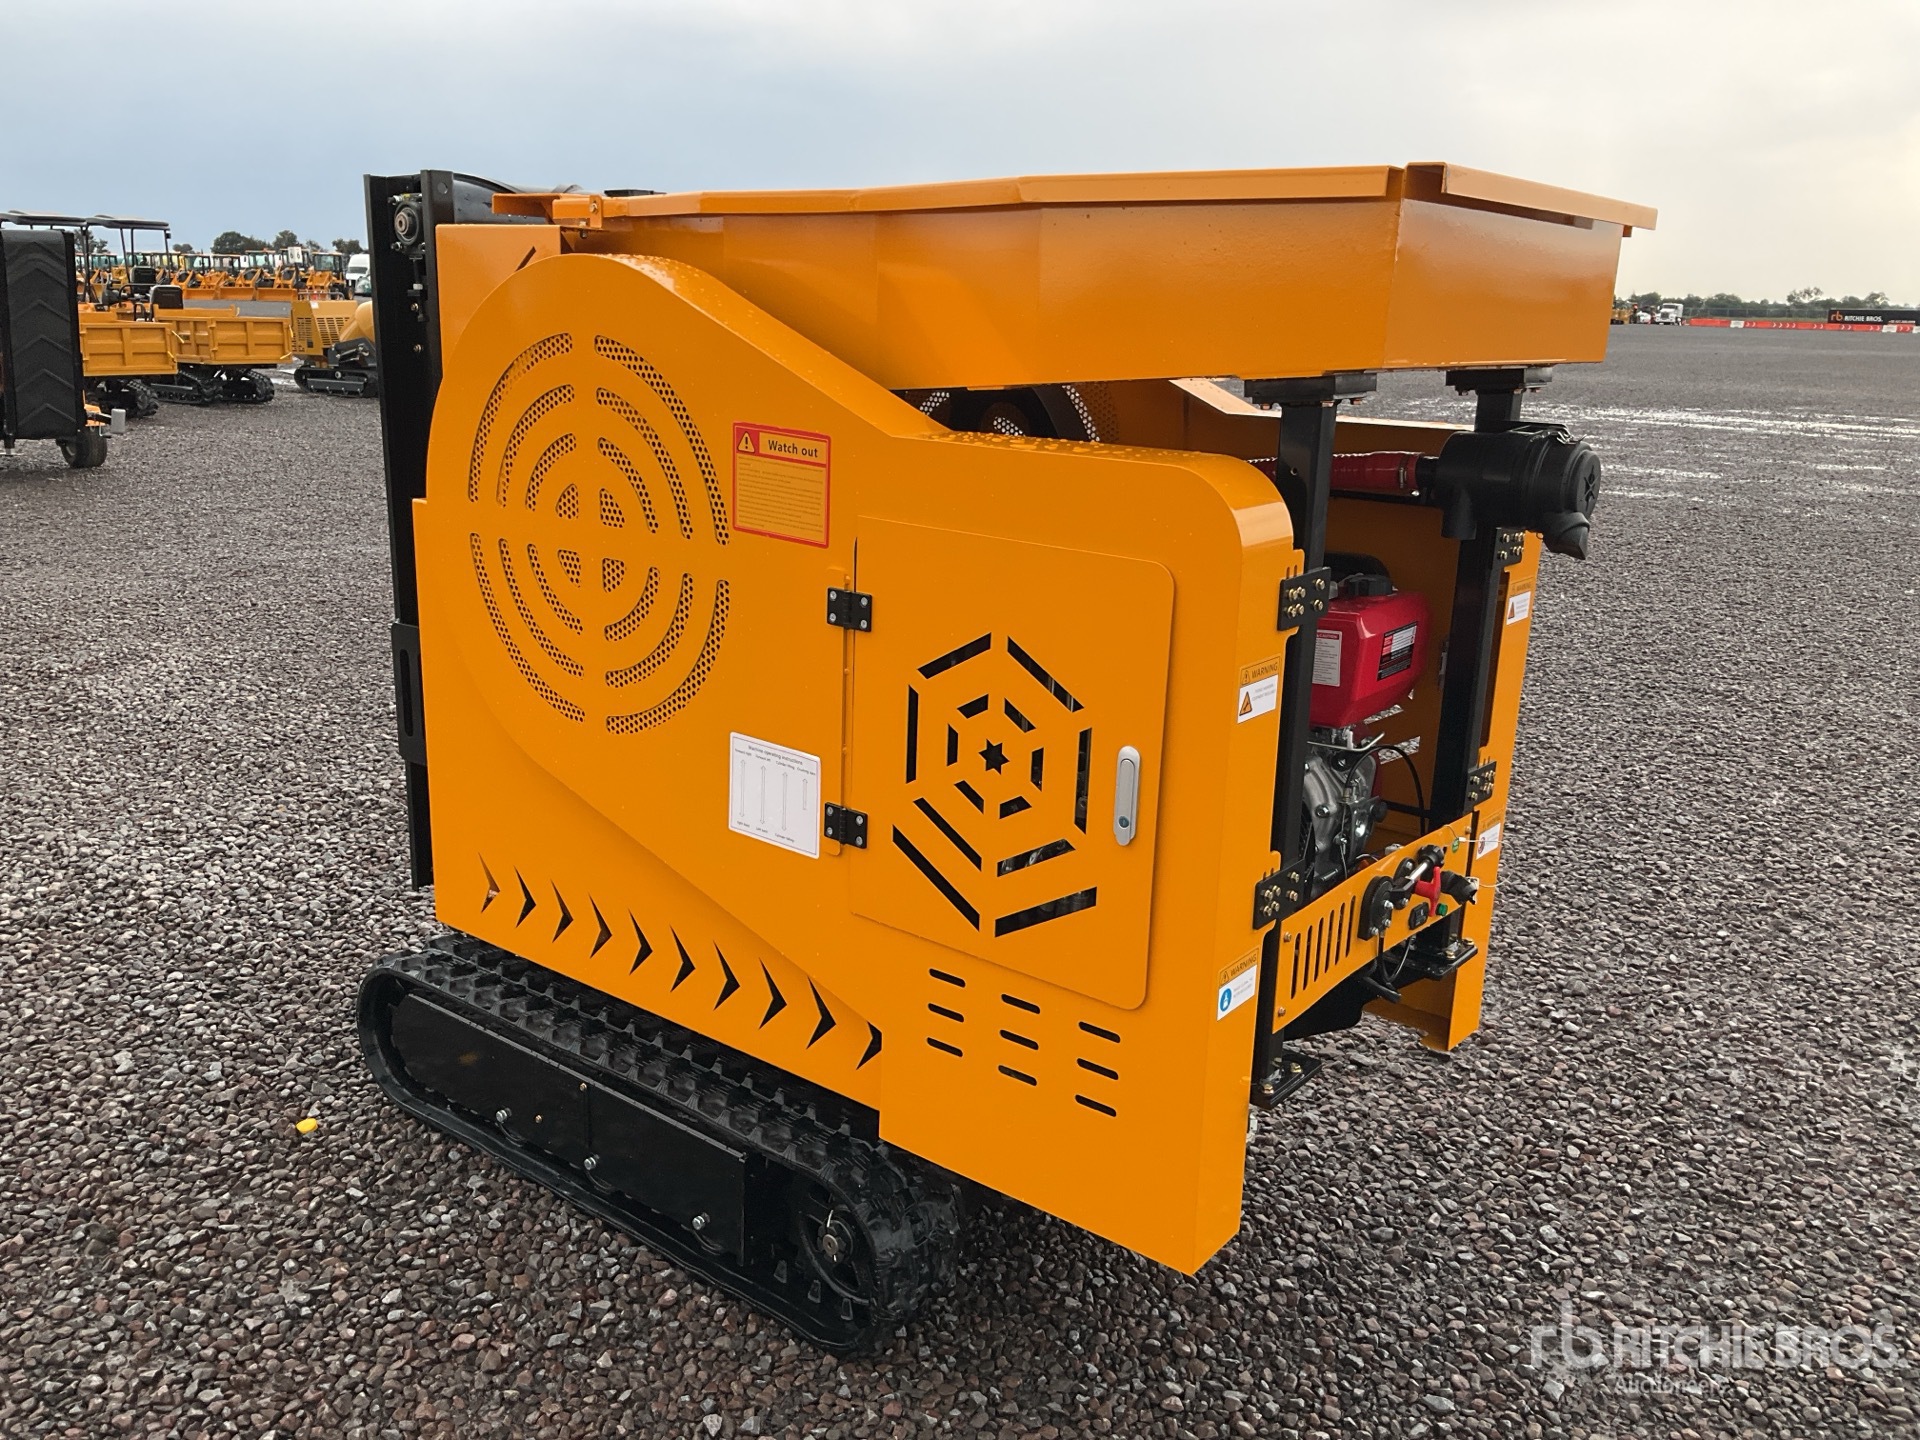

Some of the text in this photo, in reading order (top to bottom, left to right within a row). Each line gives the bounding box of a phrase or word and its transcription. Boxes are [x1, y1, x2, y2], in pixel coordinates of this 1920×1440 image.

[768, 439, 818, 458] Watch out
[1252, 662, 1278, 678] WARNING
[1230, 953, 1257, 977] WARNING
